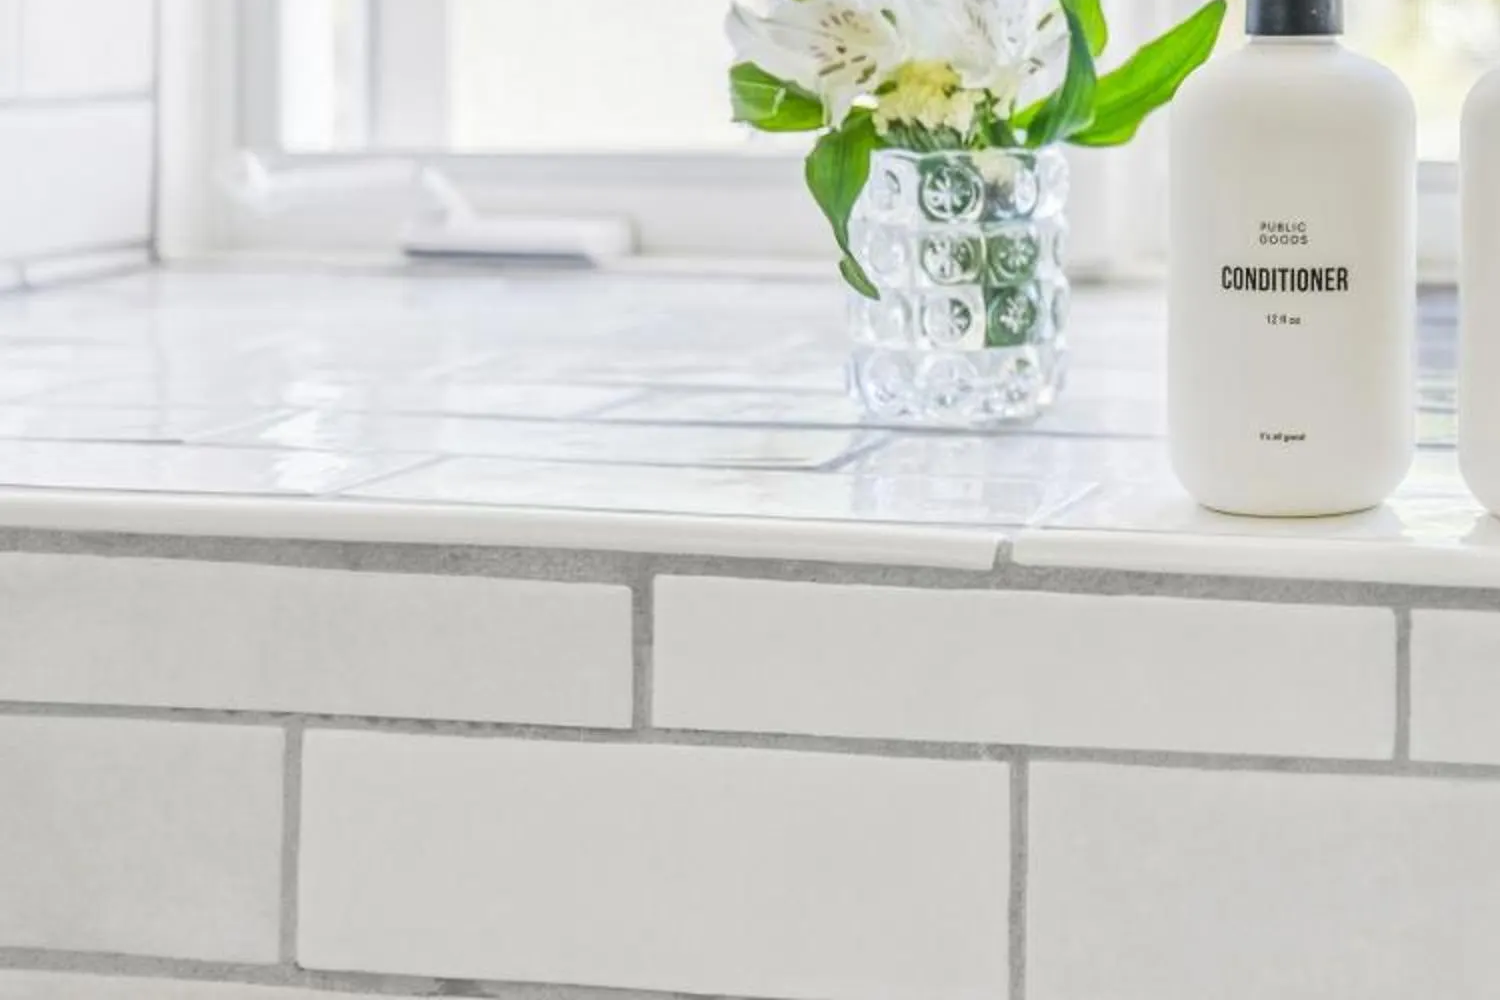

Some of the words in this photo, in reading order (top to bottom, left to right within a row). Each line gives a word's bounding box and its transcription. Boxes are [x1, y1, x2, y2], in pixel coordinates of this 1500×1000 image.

[1259, 221, 1307, 233] PUBLIC
[1258, 234, 1309, 246] GOODS
[1221, 264, 1349, 293] CONDITIONER
[1266, 313, 1278, 325] 12
